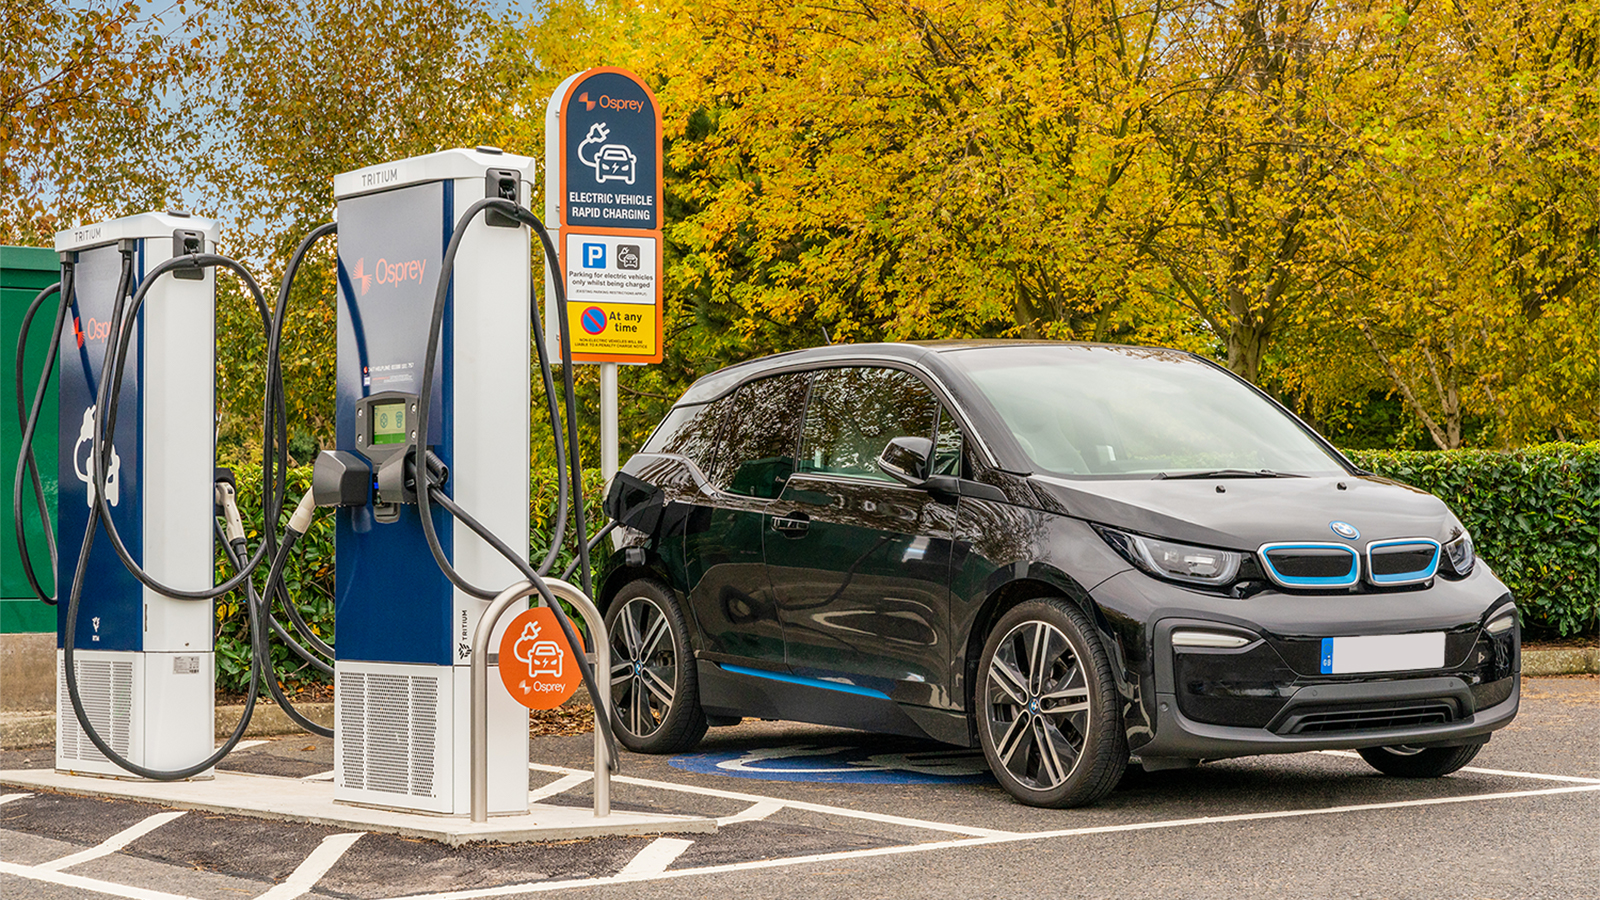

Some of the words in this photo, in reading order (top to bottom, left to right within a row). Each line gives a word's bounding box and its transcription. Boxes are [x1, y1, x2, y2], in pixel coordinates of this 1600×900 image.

[599, 94, 645, 113] Osprey
[361, 168, 398, 187] TRITIUM
[569, 191, 613, 204] ELECTRIC
[615, 193, 653, 206] VEHICLE
[572, 206, 600, 218] RAPID
[602, 207, 650, 220] CHARGING
[74, 227, 101, 243] TRITIUM
[588, 245, 603, 266] P
[375, 257, 427, 288] Osprey
[568, 270, 593, 279] Parking
[606, 280, 624, 288] being
[625, 281, 651, 289] charged
[608, 311, 621, 321] At
[624, 313, 643, 323] any
[614, 322, 638, 333] time
[533, 680, 566, 694] Osprey
